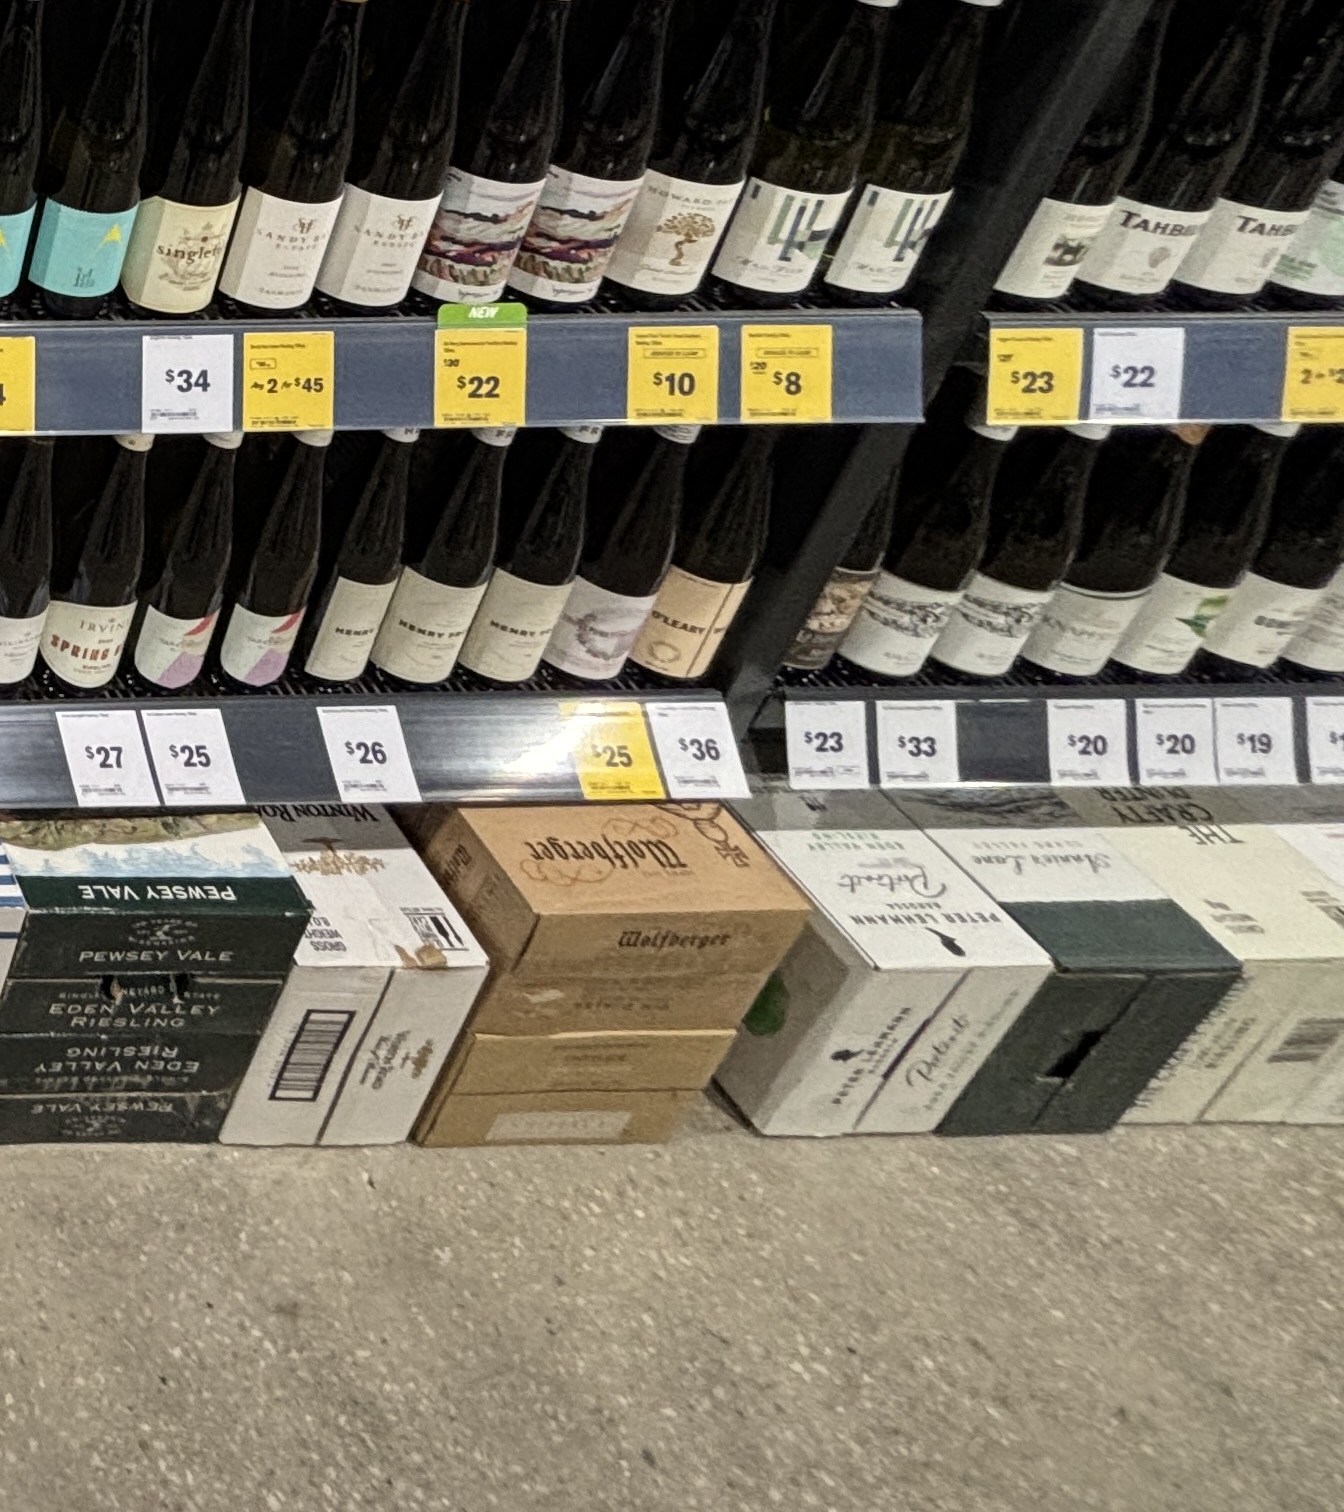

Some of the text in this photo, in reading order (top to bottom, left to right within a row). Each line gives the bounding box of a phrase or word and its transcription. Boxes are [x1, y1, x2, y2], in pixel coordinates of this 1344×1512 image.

[468, 306, 500, 319] NEW
[165, 369, 211, 393] $34
[294, 377, 325, 393] $45
[457, 376, 501, 399] $22
[652, 372, 696, 397] $10
[772, 371, 802, 395] $8
[1010, 371, 1055, 394] $23
[1113, 365, 1156, 388] $22
[50, 634, 110, 662] SPRING
[345, 741, 388, 765] $26
[679, 737, 720, 762] $36
[804, 731, 844, 753] $23
[897, 735, 938, 758] $33
[1067, 734, 1108, 757] $20
[1156, 733, 1196, 755] $20
[1237, 732, 1273, 755] $19
[84, 745, 124, 769] $27
[169, 744, 211, 768] $25
[78, 884, 238, 900] PEWSEY VALE
[78, 950, 234, 963] PEWSEY VALE
[49, 1003, 222, 1015] EDEN VALLEY
[70, 1017, 185, 1028] RIESLING
